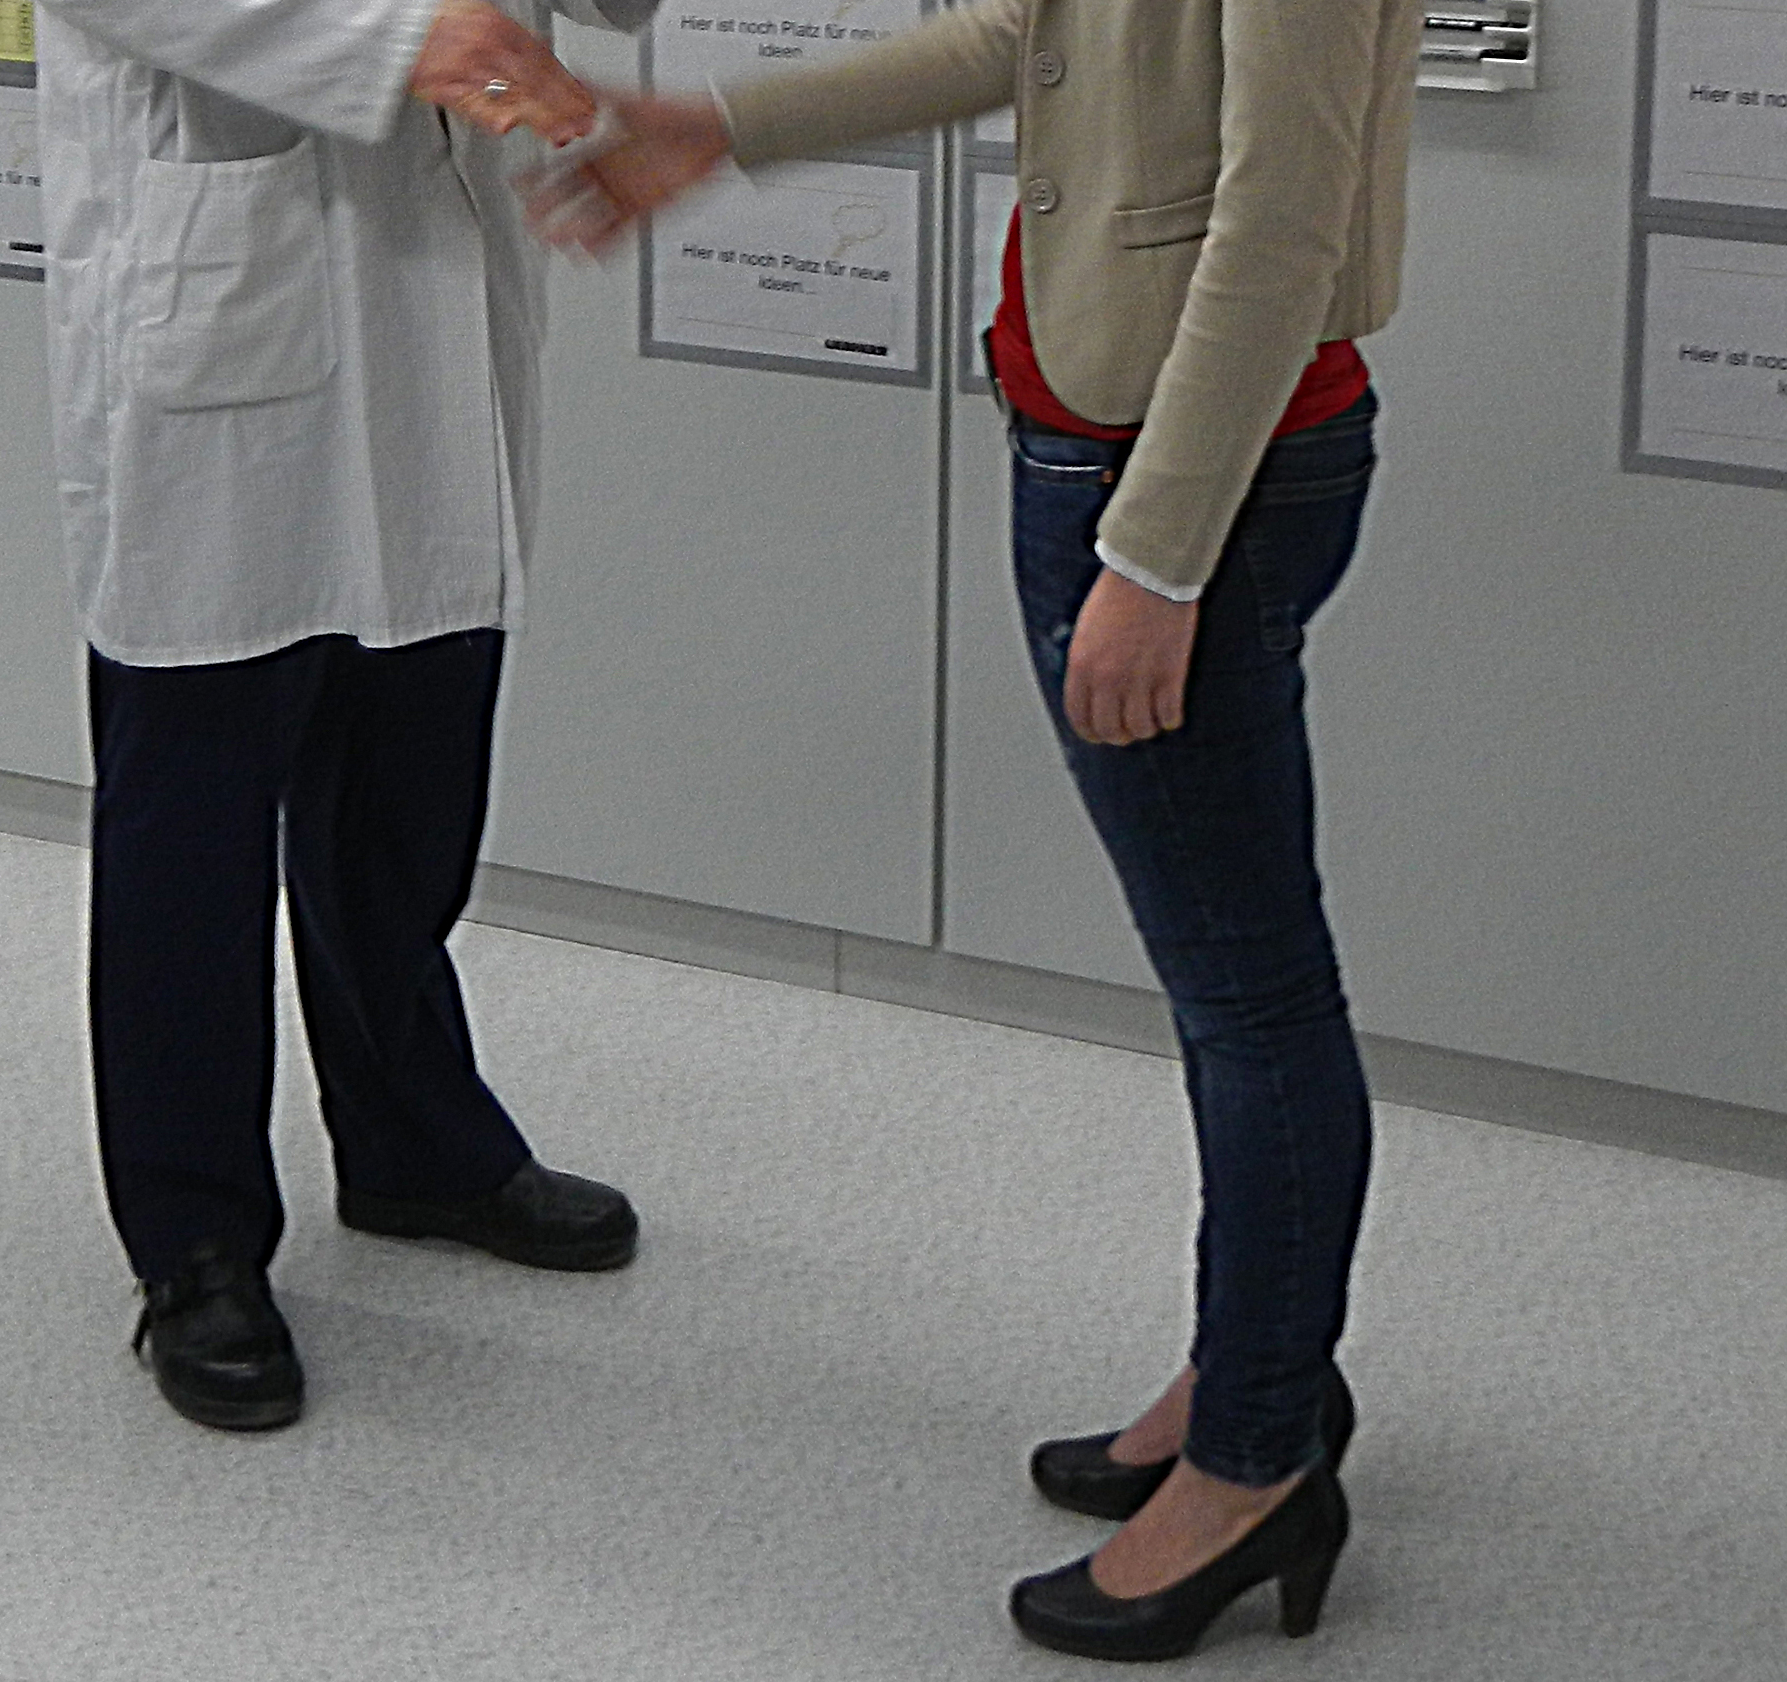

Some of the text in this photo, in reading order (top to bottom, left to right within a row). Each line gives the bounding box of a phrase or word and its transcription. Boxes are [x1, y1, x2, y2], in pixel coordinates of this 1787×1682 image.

[680, 16, 713, 32] Hier
[716, 18, 735, 33] ist
[738, 20, 778, 36] noch
[780, 19, 821, 38] Platz
[824, 22, 847, 39] für
[1689, 84, 1787, 108] Hier ist no
[682, 242, 892, 282] Hier ist noch Platz für neue
[1679, 344, 1719, 363] Hier
[1726, 348, 1749, 366] ist
